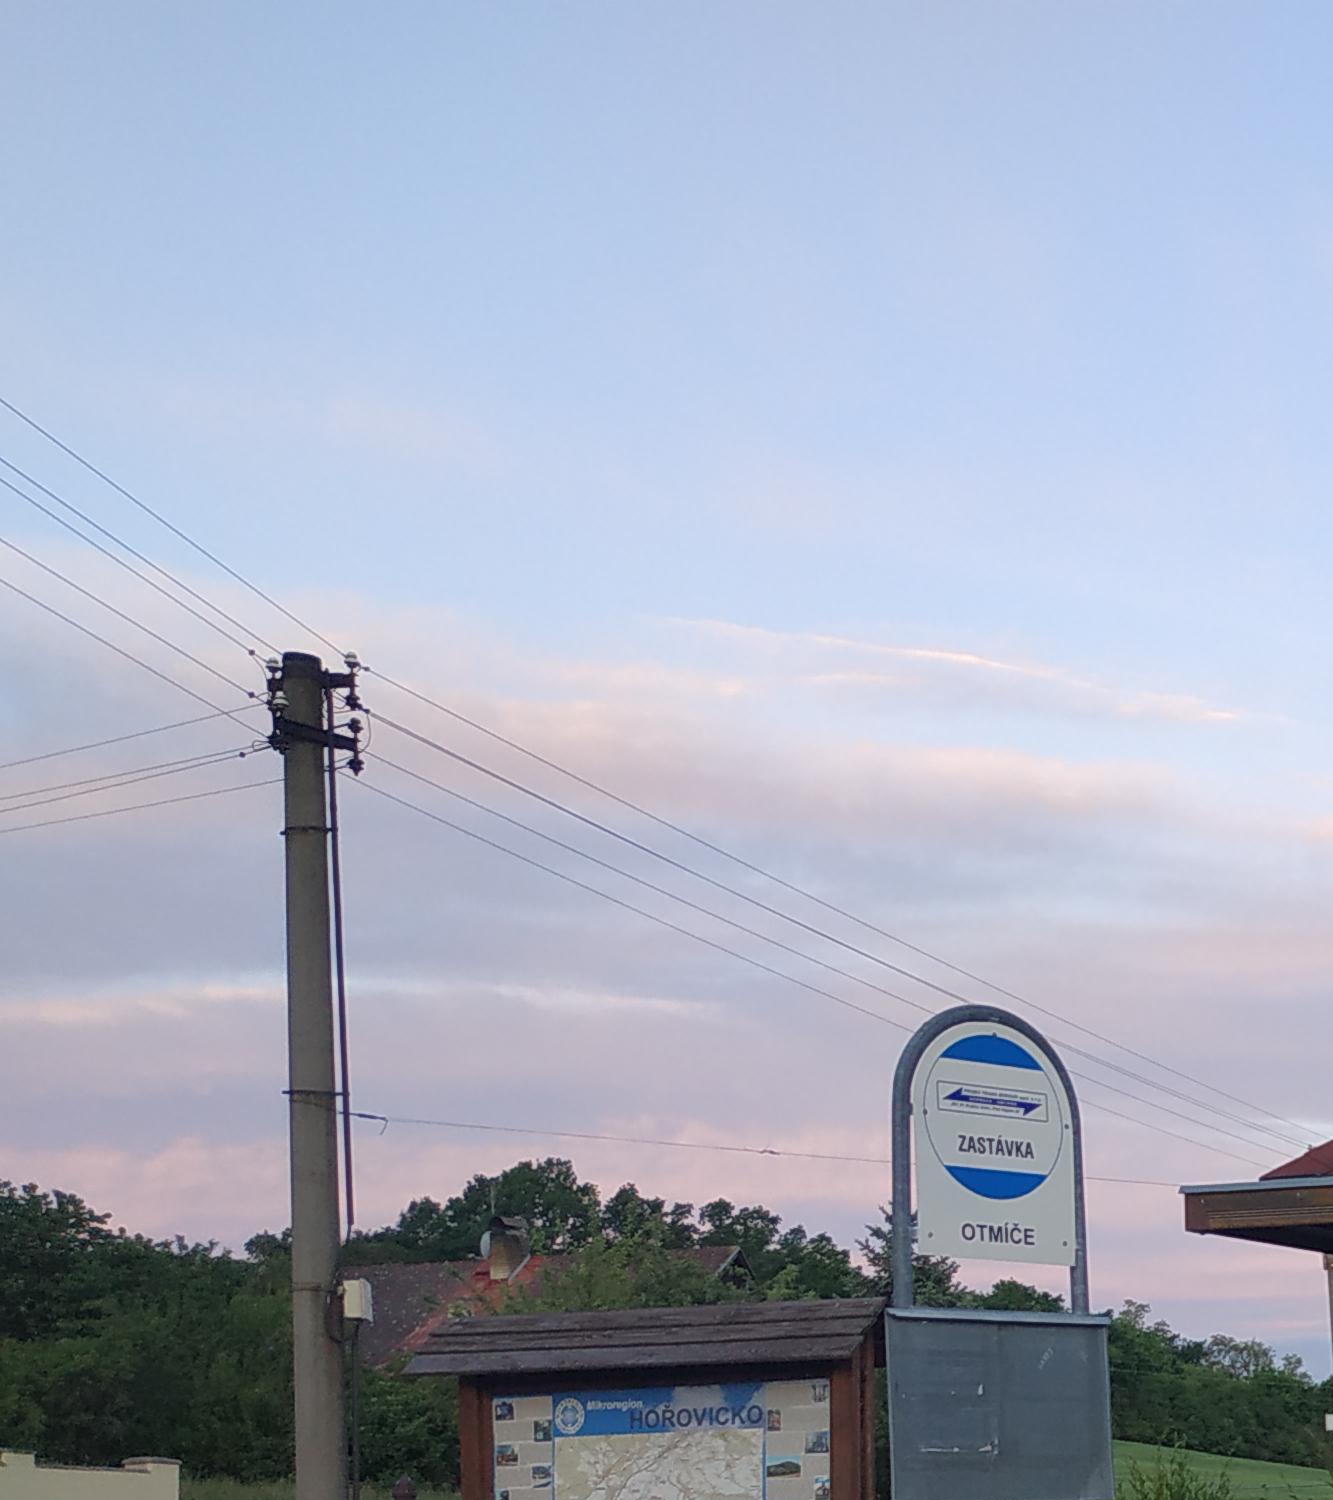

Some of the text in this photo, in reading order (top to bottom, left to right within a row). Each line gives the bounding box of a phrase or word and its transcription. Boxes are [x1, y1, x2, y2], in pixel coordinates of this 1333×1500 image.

[958, 1134, 1034, 1159] ZASTÁVKA
[961, 1222, 1035, 1245] OTMÍČE
[586, 1398, 643, 1411] Mikroregion
[630, 1404, 763, 1429] HOŘOVICKO
